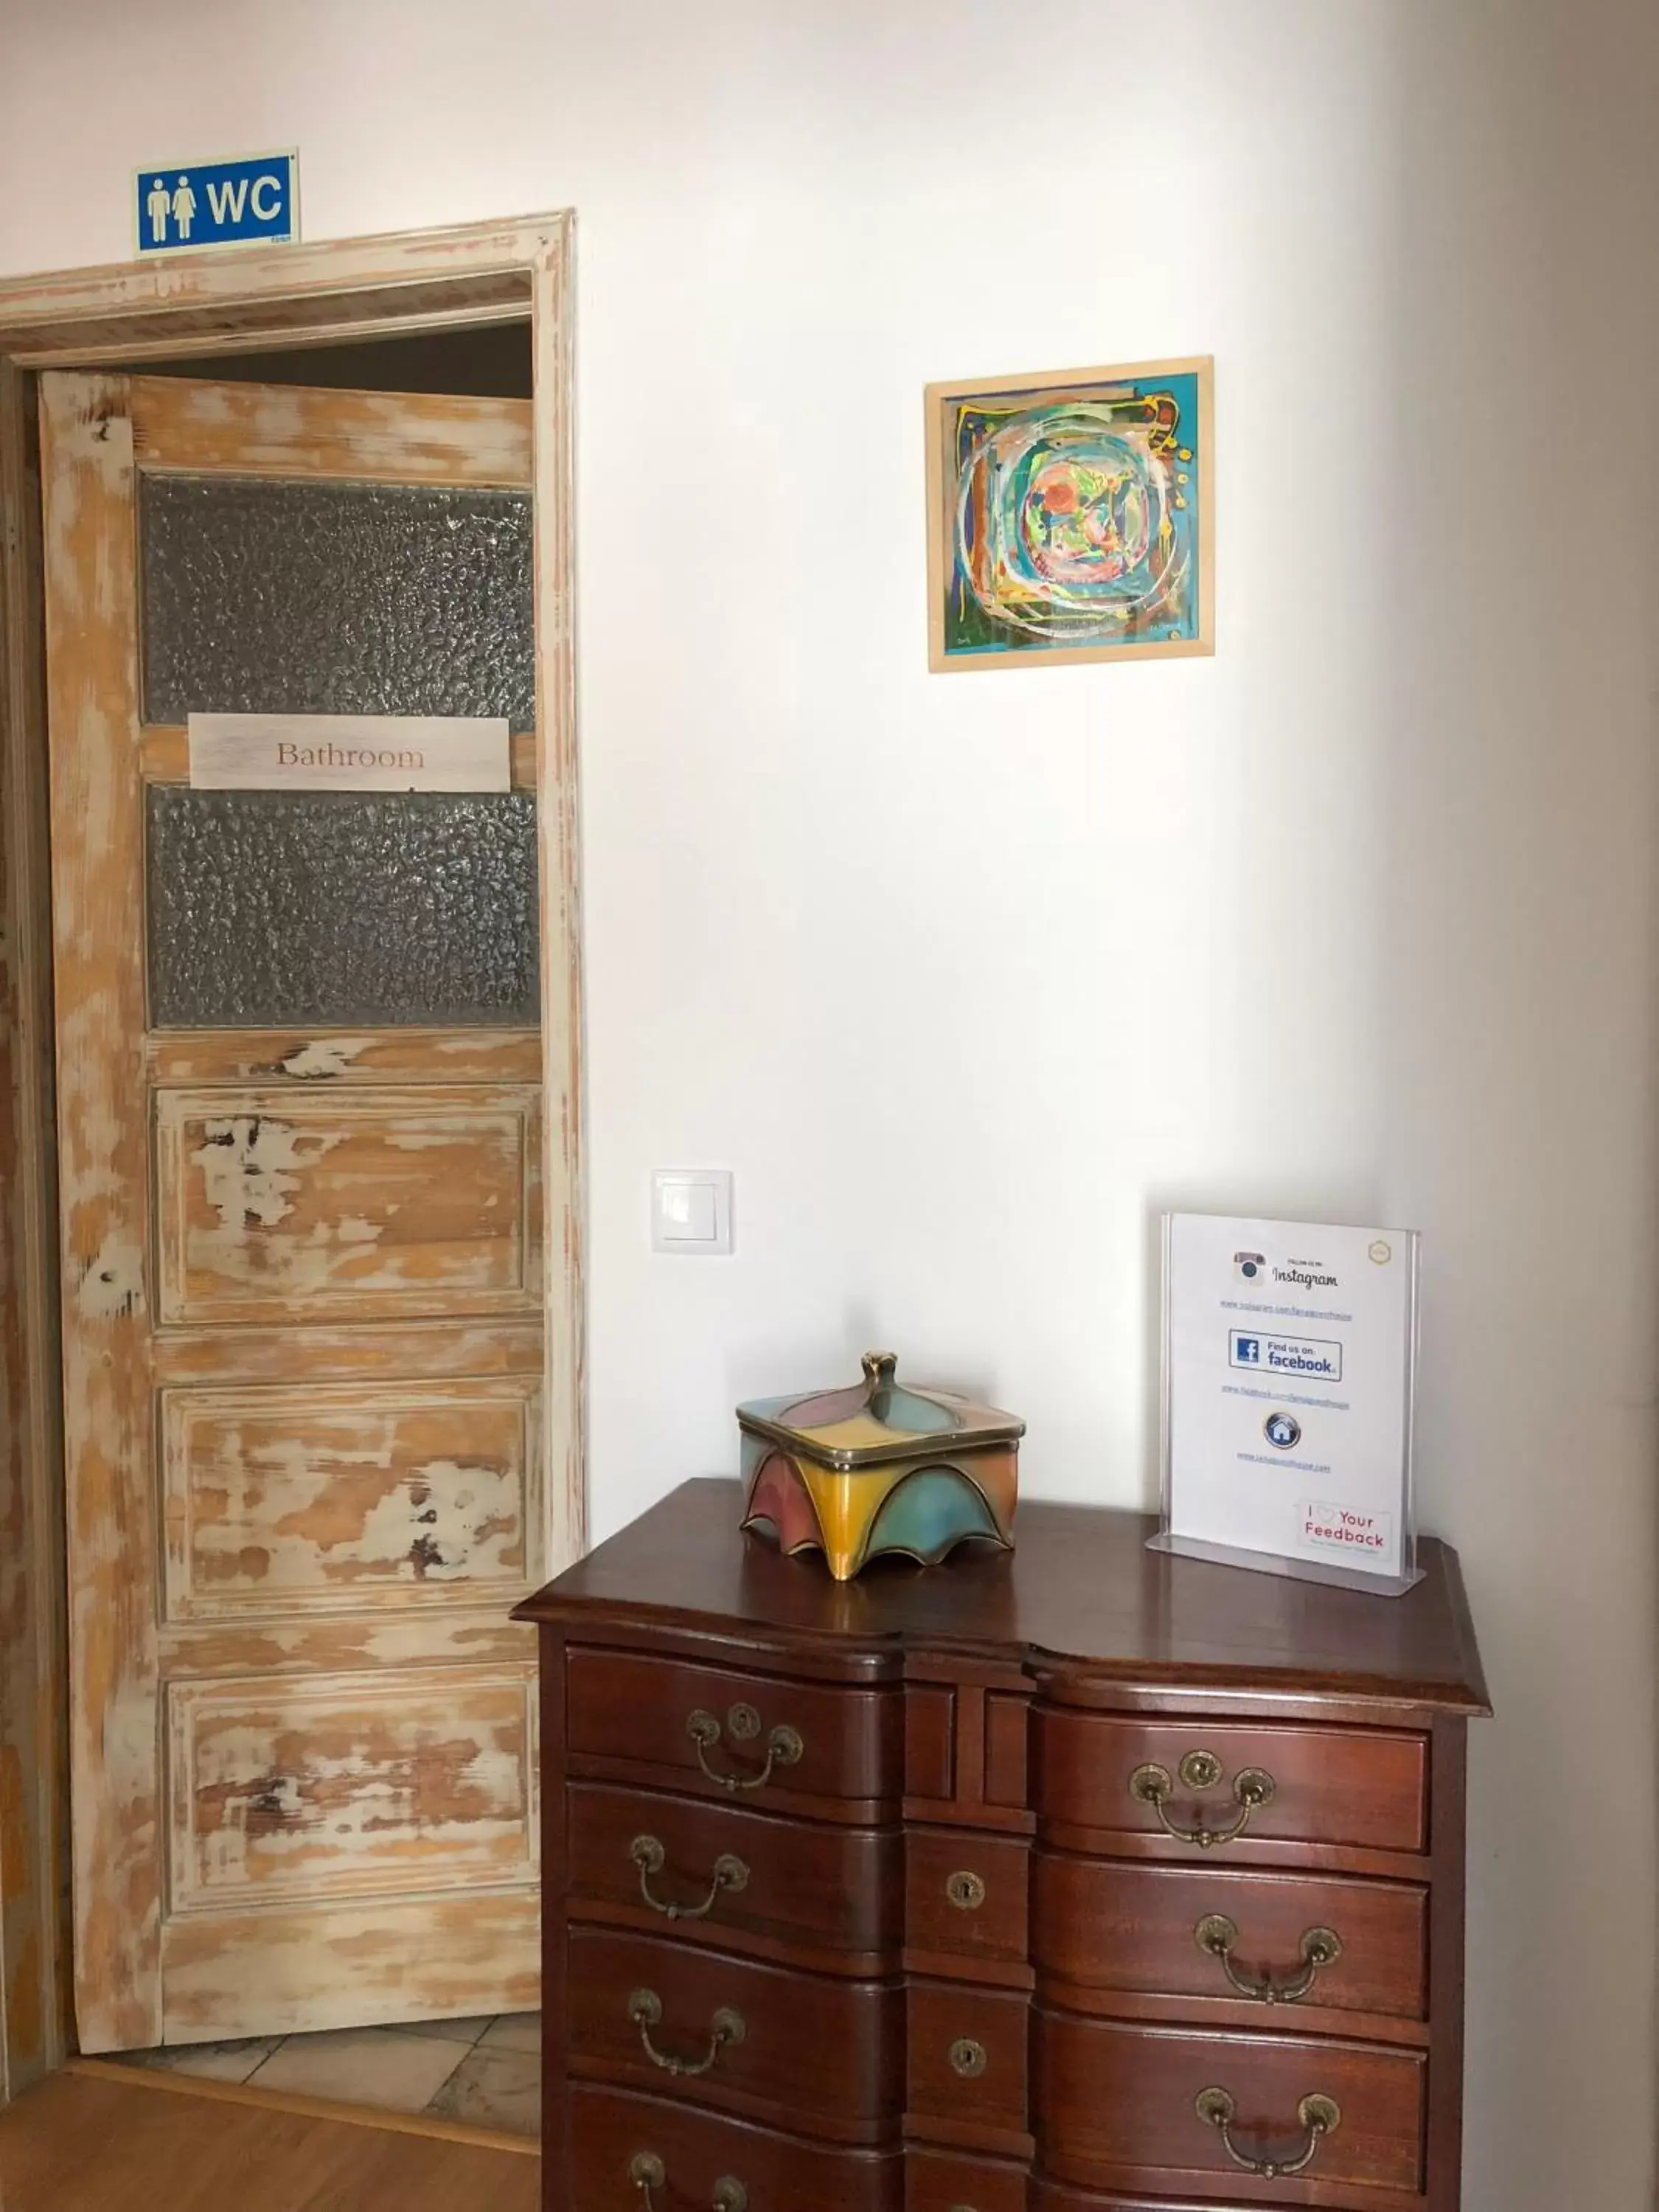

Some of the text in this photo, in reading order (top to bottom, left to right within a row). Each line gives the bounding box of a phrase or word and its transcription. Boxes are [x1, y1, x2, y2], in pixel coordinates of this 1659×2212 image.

[206, 175, 282, 225] WC
[277, 742, 425, 769] Bathroom
[1272, 1267, 1338, 1290] Instagram
[1267, 1341, 1287, 1352] Find
[1340, 1510, 1374, 1528] Your
[1305, 1522, 1383, 1547] Feedback
